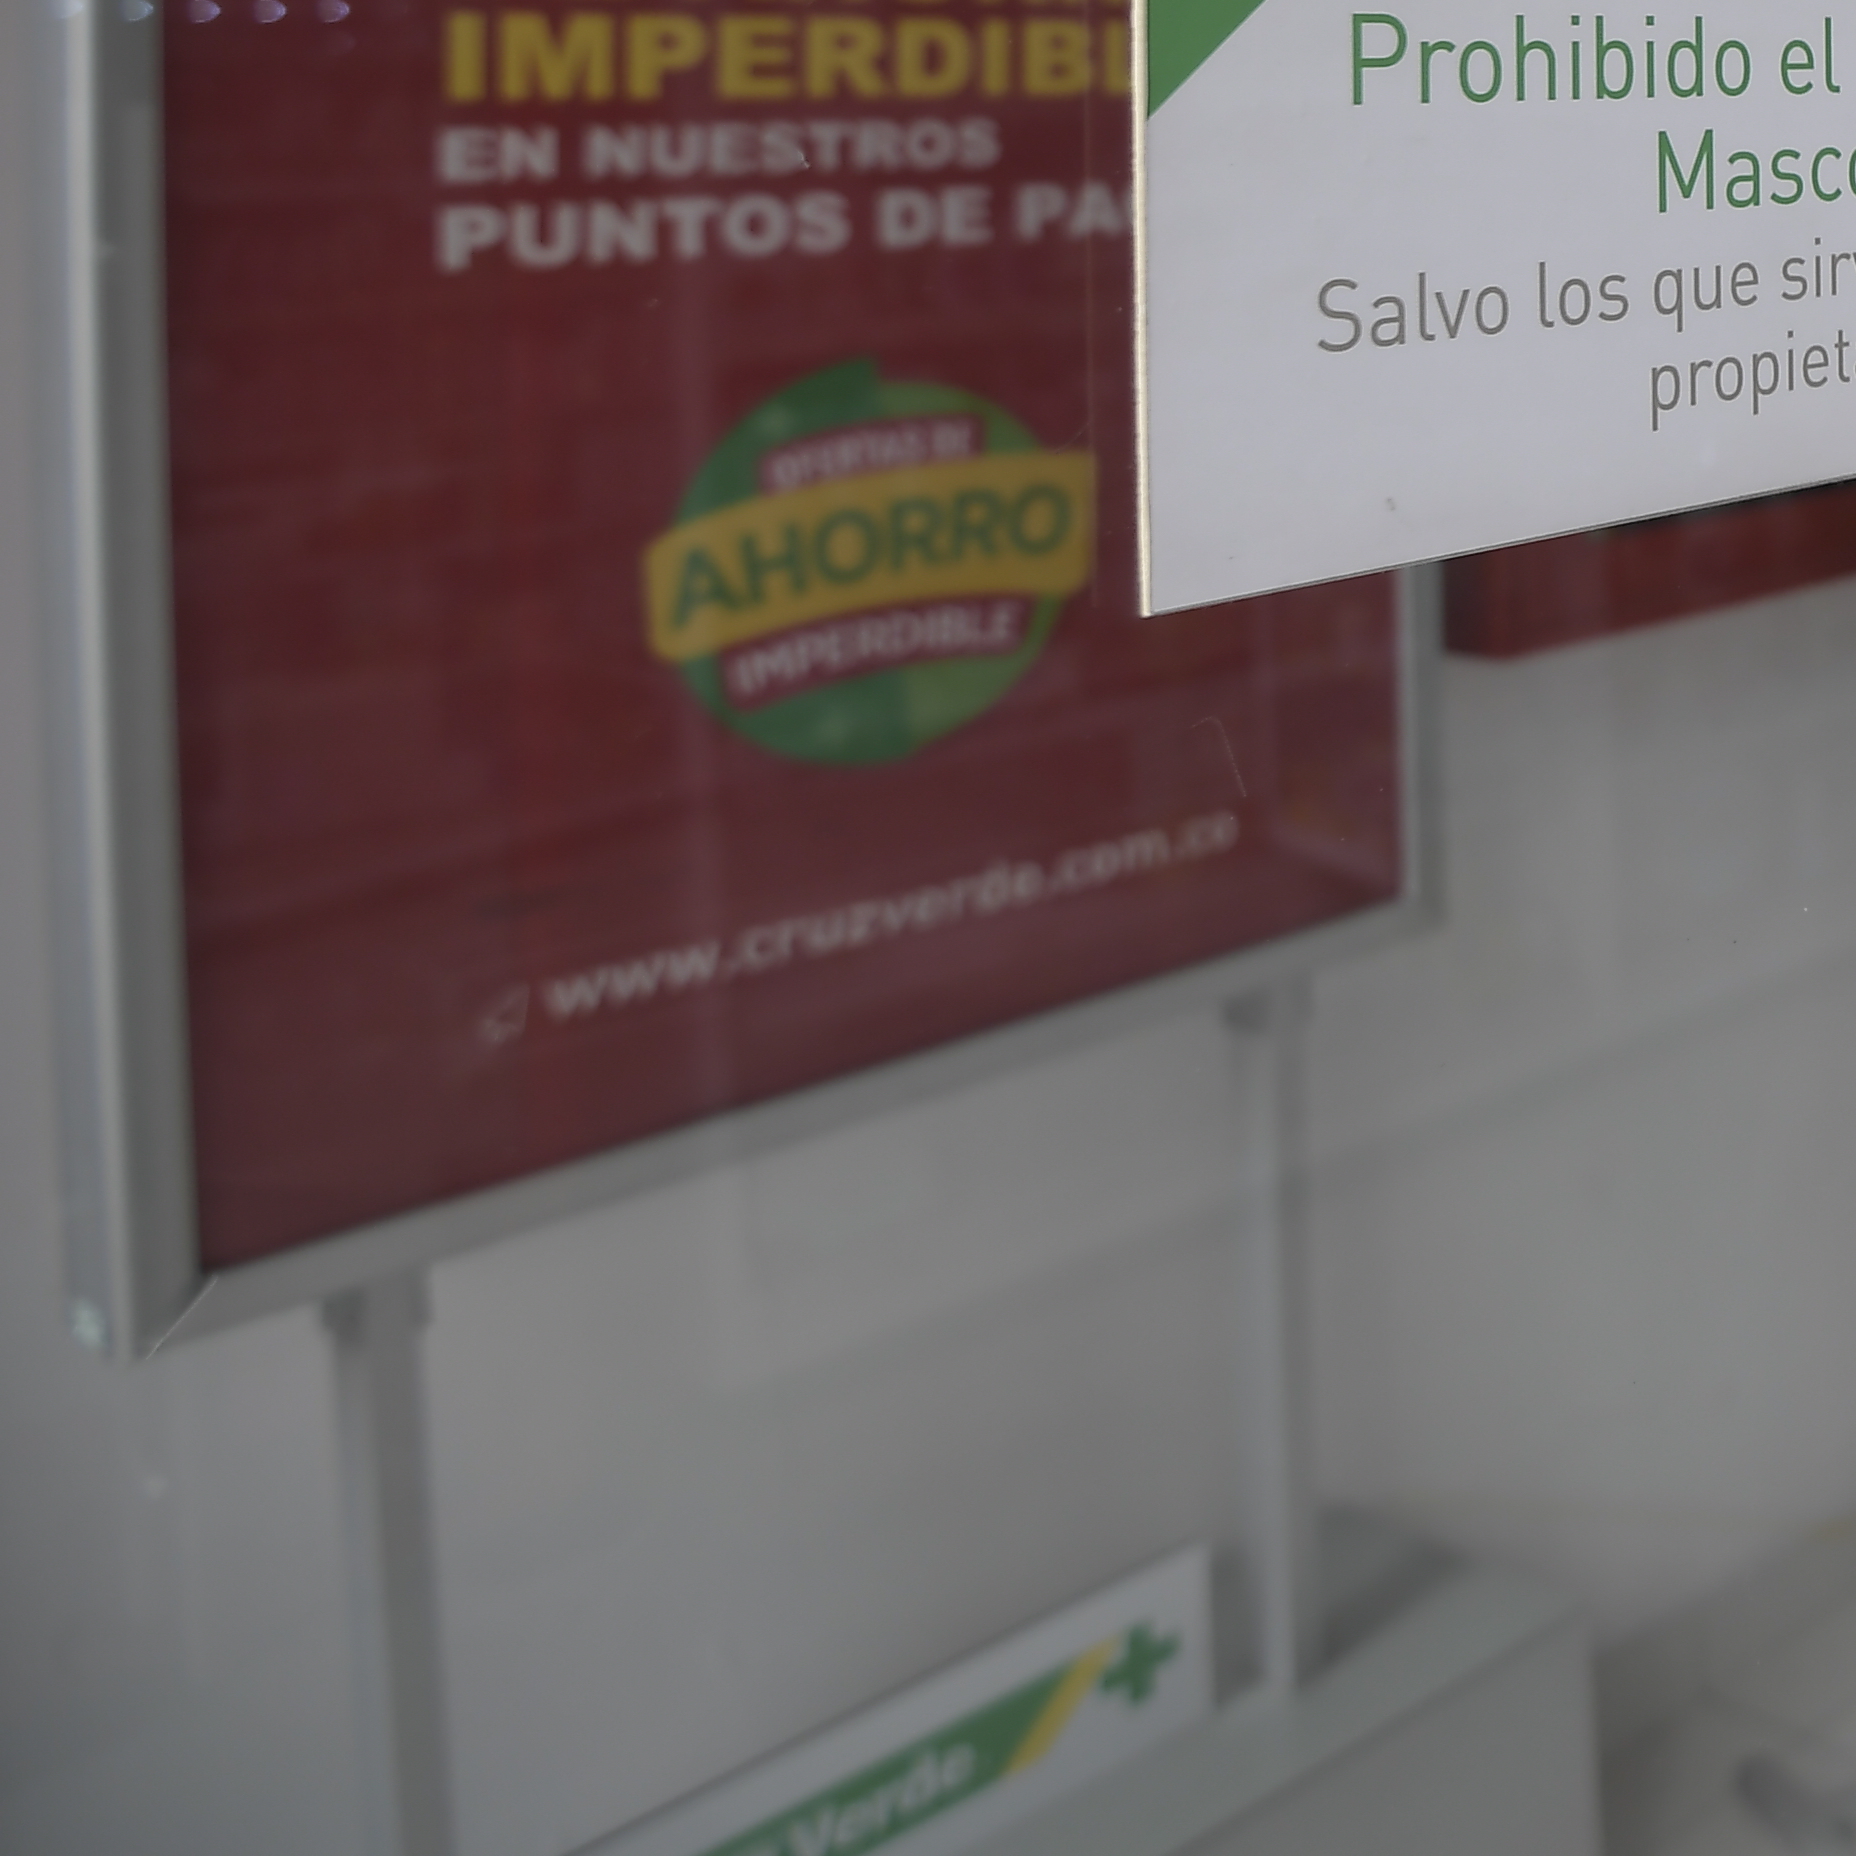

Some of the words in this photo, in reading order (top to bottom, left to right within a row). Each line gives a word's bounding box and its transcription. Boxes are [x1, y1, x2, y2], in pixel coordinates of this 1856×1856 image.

[1350, 12, 1752, 106] Prohibido
[1780, 16, 1841, 95] el
[437, 125, 559, 185] EN
[580, 117, 1002, 178] NUESTROS
[437, 190, 851, 274] PUNTOS
[875, 185, 992, 249] DE
[1317, 271, 1510, 353] Salvo
[1537, 260, 1631, 330] los
[1652, 261, 1760, 333] que
[667, 482, 1075, 632] AHORRO
[730, 599, 1025, 698] IMPERDIBLE
